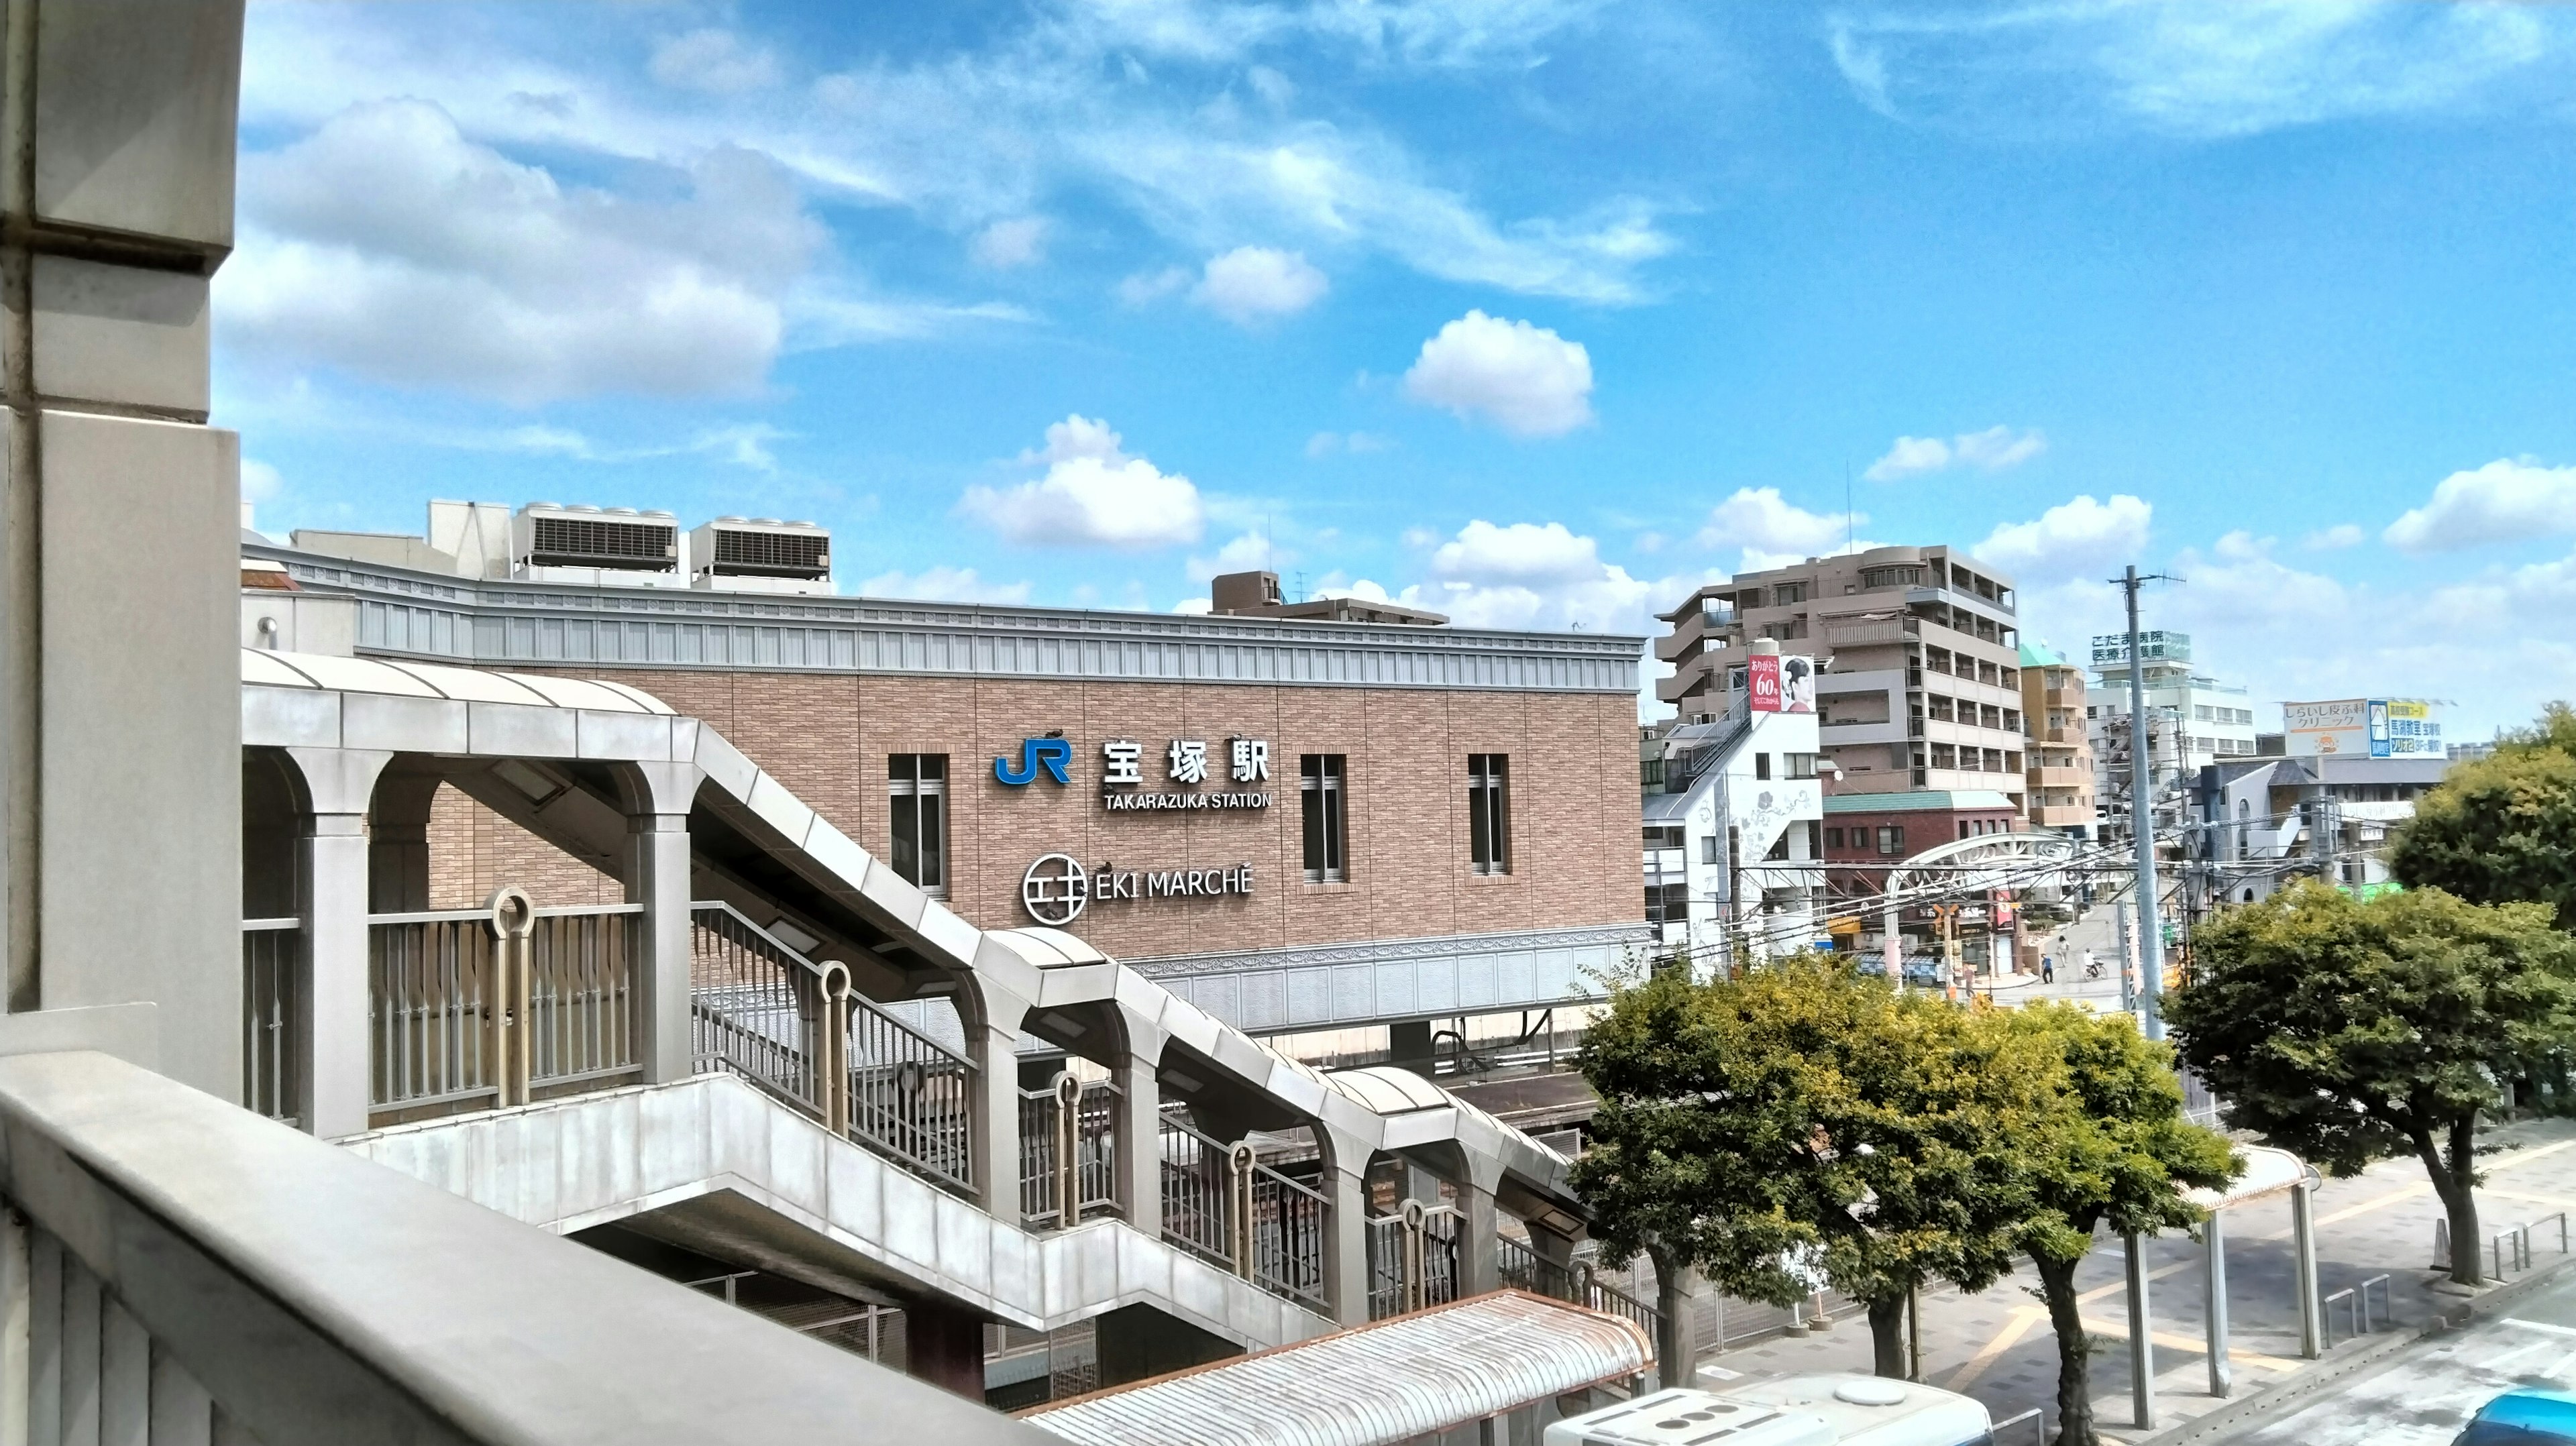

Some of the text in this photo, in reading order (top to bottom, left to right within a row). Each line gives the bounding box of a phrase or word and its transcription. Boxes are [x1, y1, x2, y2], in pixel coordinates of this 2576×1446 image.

[1752, 660, 1778, 672] ありがとう
[2286, 703, 2365, 718] しらいし皮ふ科
[2298, 715, 2354, 728] クリニック
[997, 738, 1072, 785] JR
[1104, 740, 1269, 783] 宝塚駅
[1105, 793, 1272, 810] TAKARAZUKA STATION
[1097, 873, 1140, 899] EKI
